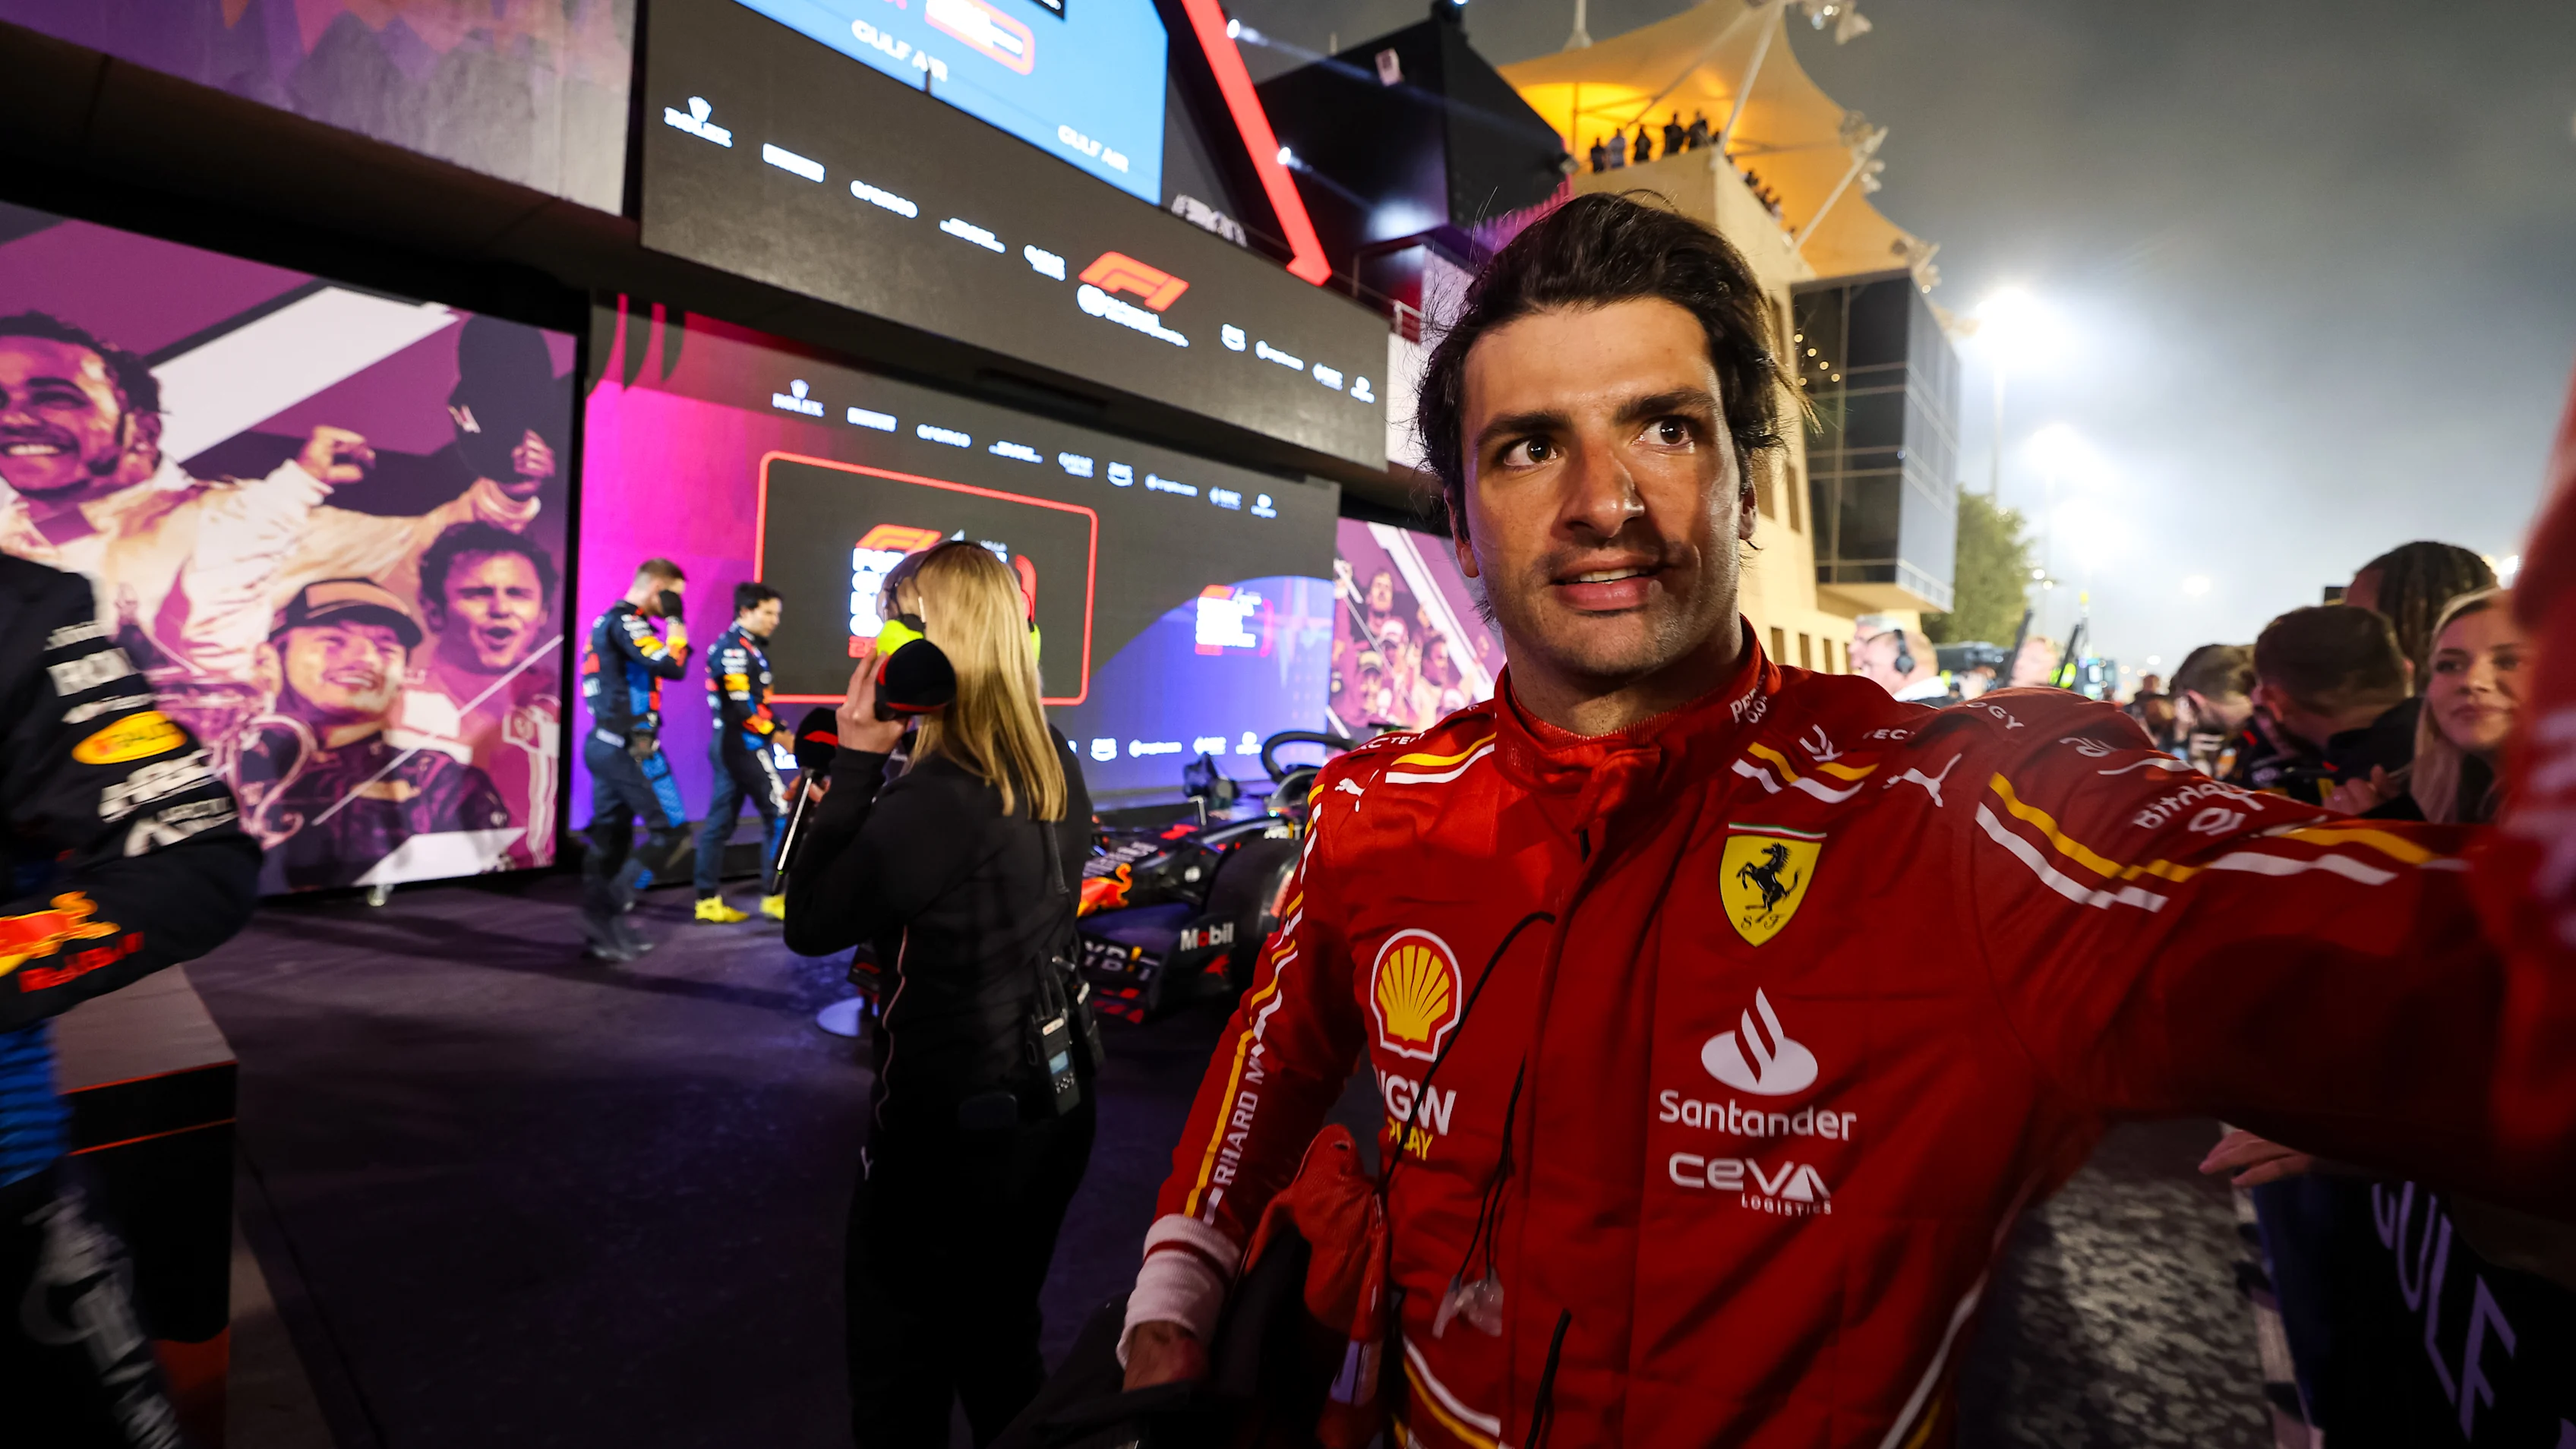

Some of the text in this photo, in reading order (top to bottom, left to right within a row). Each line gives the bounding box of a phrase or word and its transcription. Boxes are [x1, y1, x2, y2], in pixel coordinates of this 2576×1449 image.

[851, 19, 911, 61] GULF
[1180, 922, 1235, 952] Mobil
[1659, 1088, 1858, 1141] Santander
[1741, 1192, 1833, 1217] LOGISTICS
